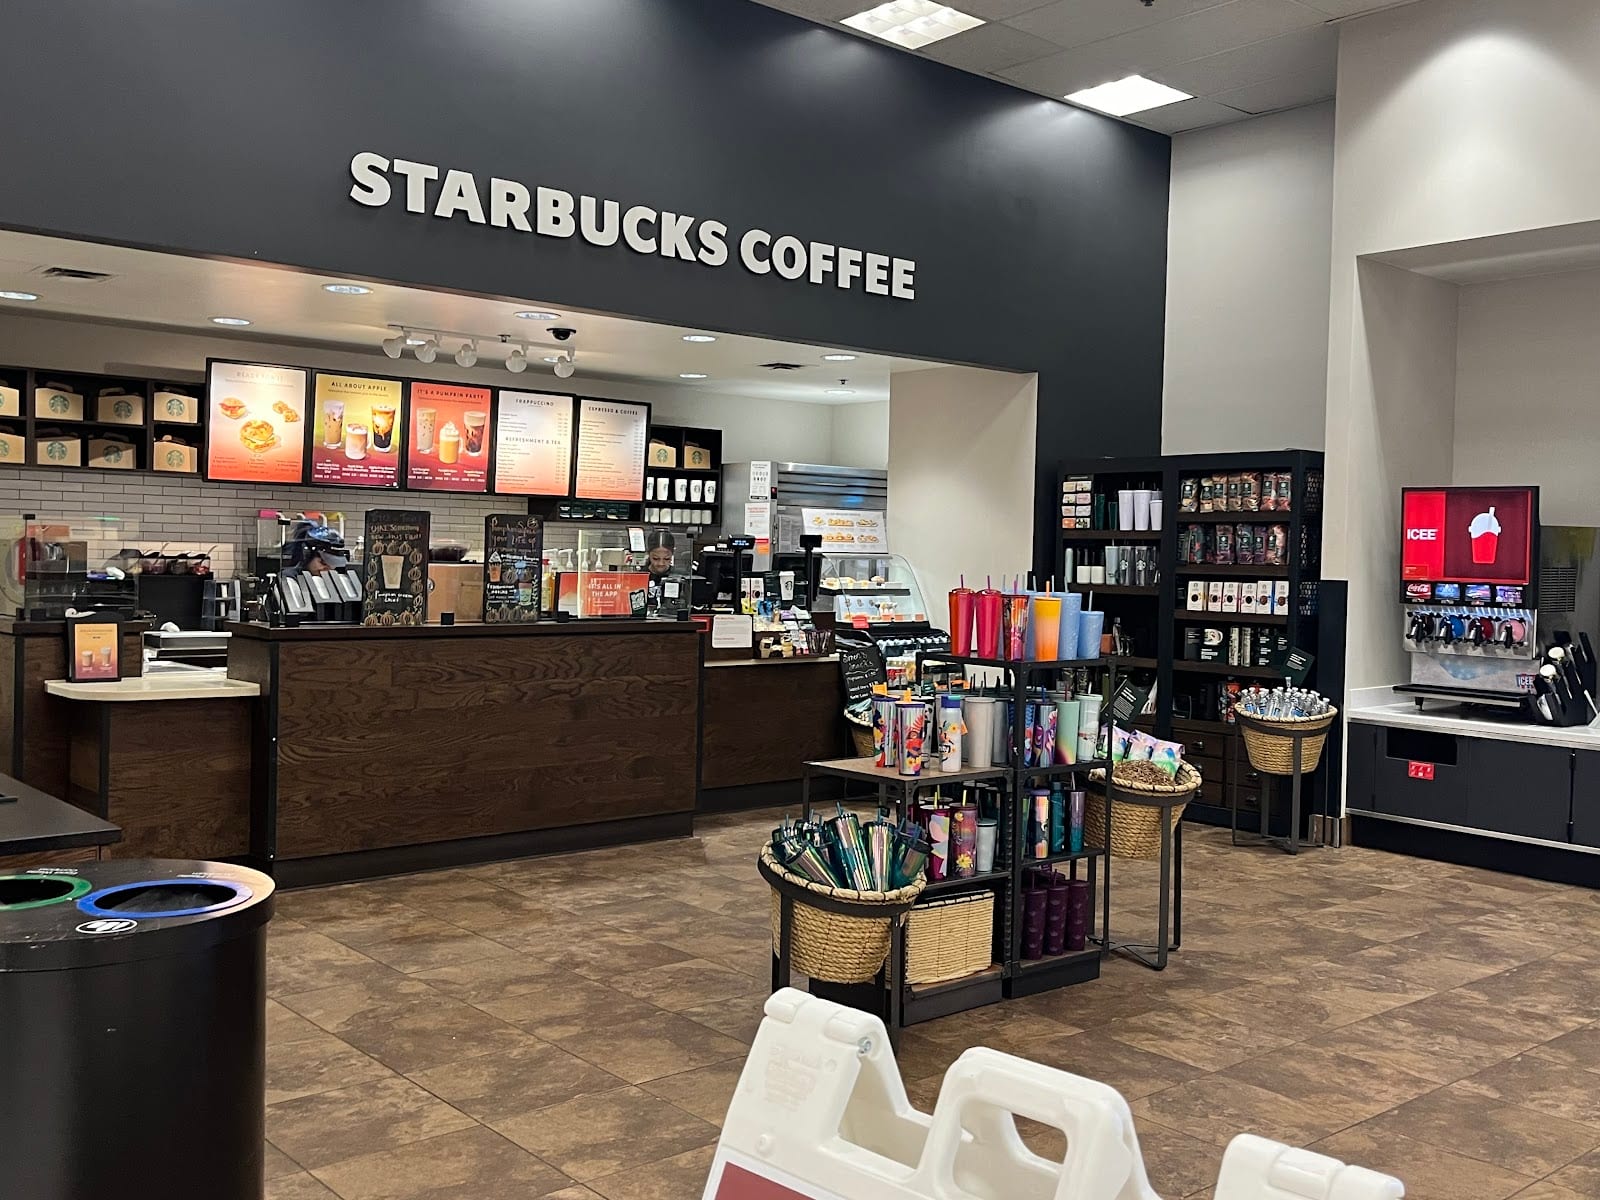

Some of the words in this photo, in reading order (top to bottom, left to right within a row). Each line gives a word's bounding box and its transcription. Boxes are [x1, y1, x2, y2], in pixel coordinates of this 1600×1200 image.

[349, 152, 728, 267] STARBUCKS
[740, 229, 916, 300] COFFEE
[344, 382, 365, 390] ABOUT
[367, 384, 387, 392] APPLE
[436, 390, 464, 398] PUMPKIN
[588, 406, 614, 414] ESPRESSO
[1407, 528, 1437, 541] ICEE
